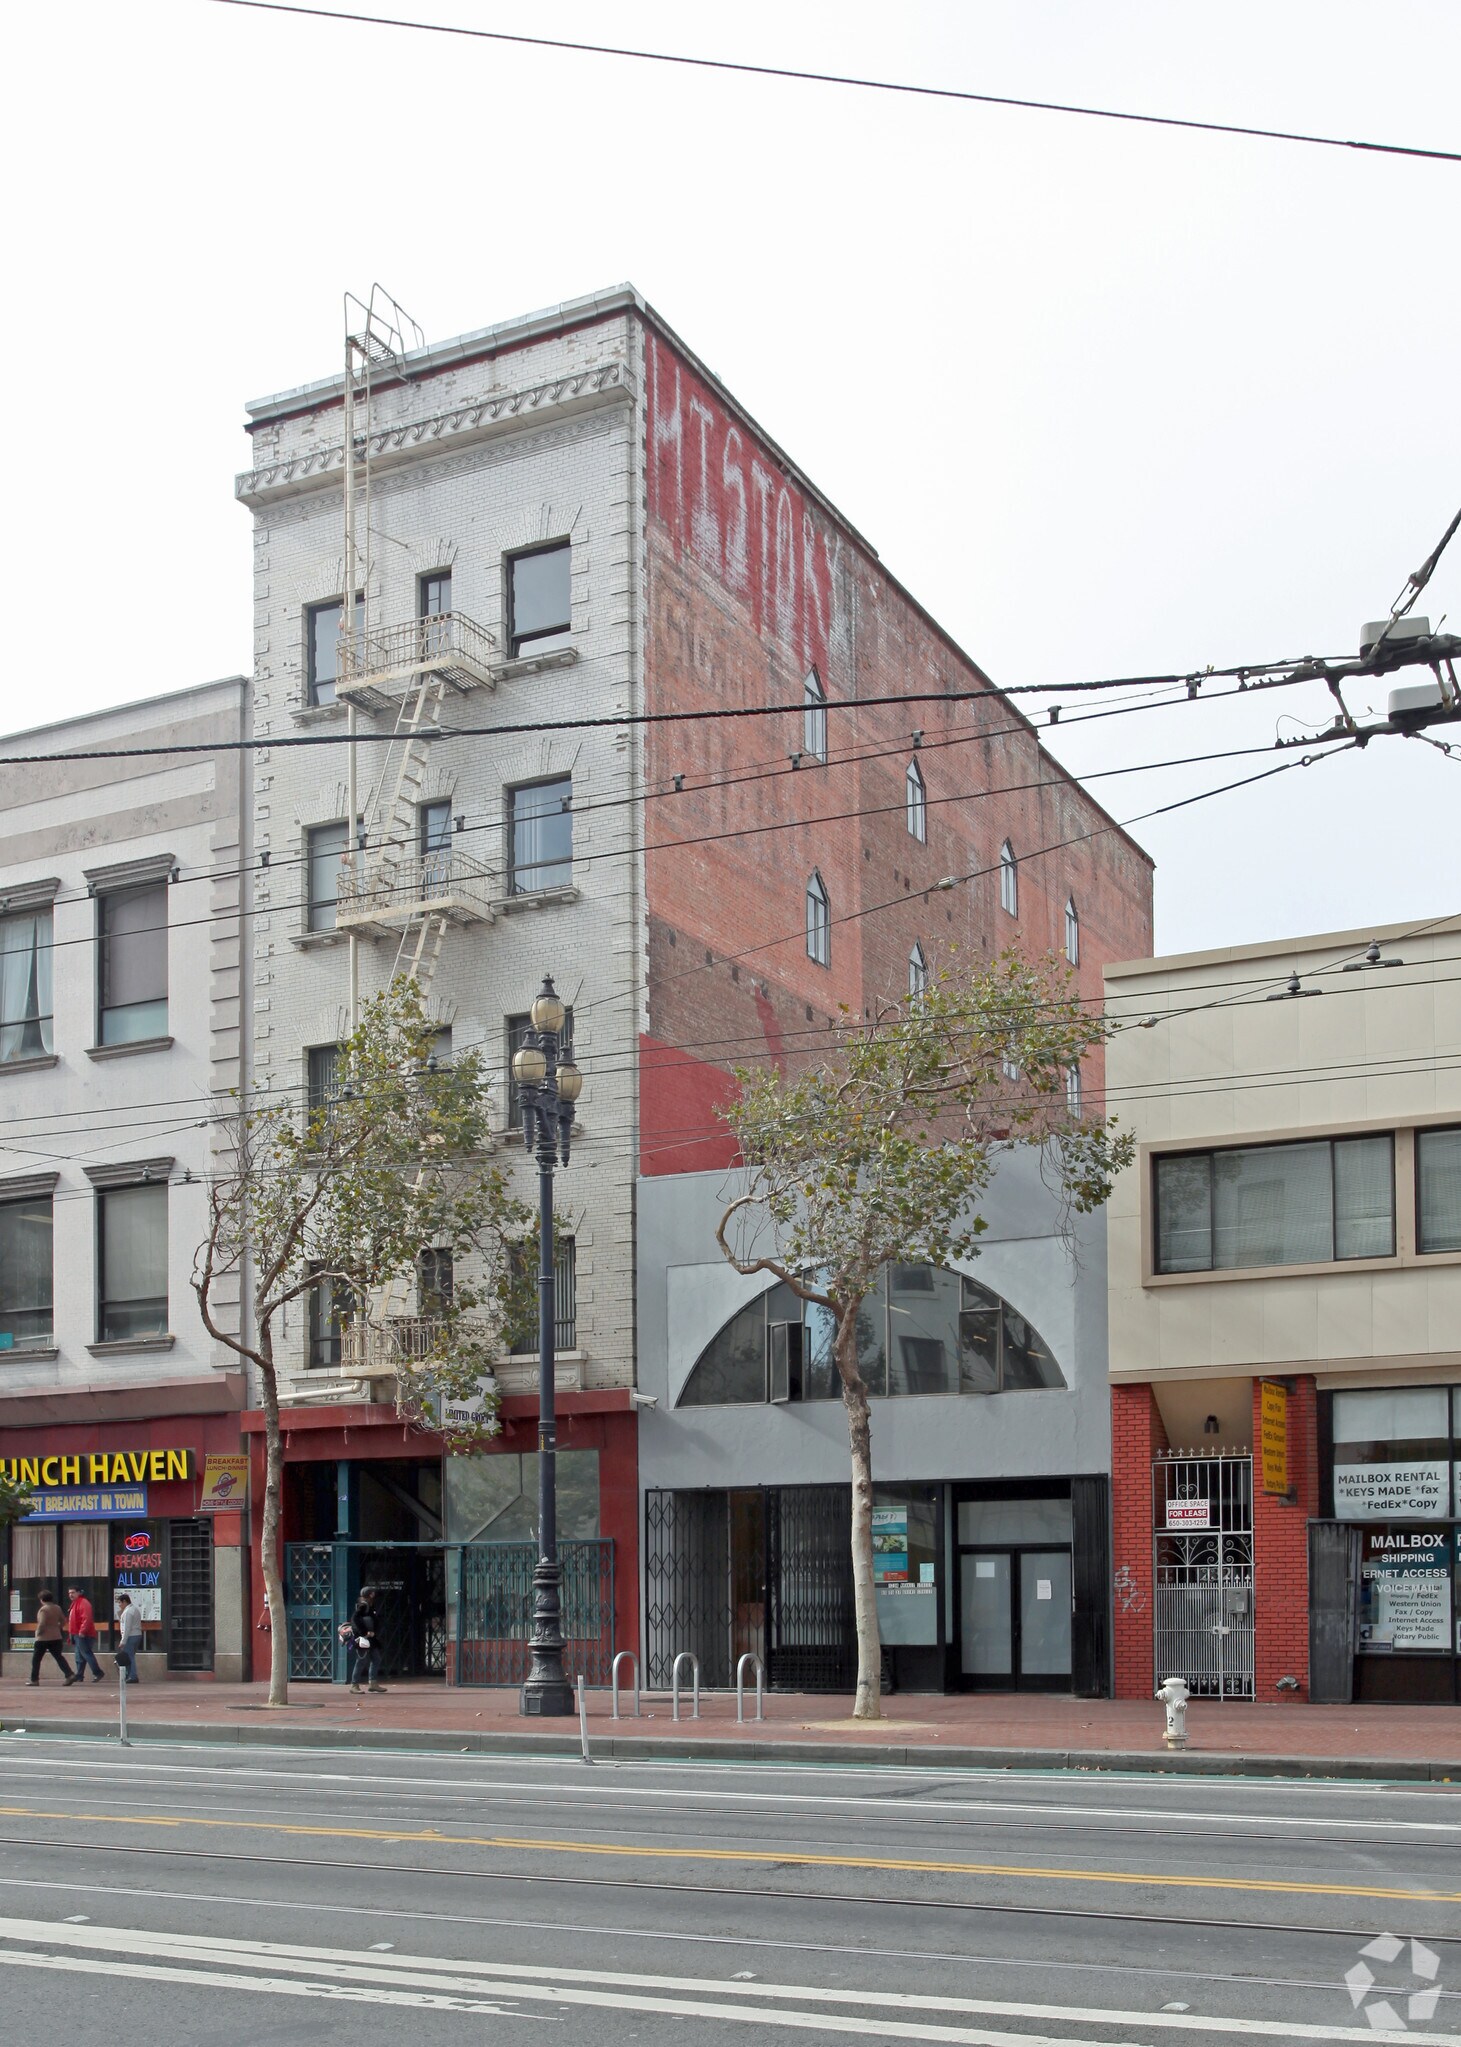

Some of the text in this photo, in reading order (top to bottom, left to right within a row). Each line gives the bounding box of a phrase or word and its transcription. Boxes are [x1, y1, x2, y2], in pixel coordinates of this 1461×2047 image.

[89, 1449, 188, 1485] HAVEN
[1338, 1472, 1440, 1484] MAILBOX RENTAL
[1378, 1486, 1411, 1496] MADE
[45, 1494, 99, 1512] BREAKFAST
[101, 1493, 112, 1510] IN
[114, 1493, 144, 1509] TOWN
[1184, 1509, 1207, 1517] LEASE
[125, 1536, 149, 1548] OPEN
[1371, 1534, 1444, 1549] MAILBOX
[114, 1553, 161, 1569] BREAKFAST
[1381, 1553, 1435, 1563] SHIPPING
[117, 1571, 159, 1586] ALL DAY
[1402, 1568, 1447, 1578] ACCESS
[1415, 1609, 1433, 1617] Copy
